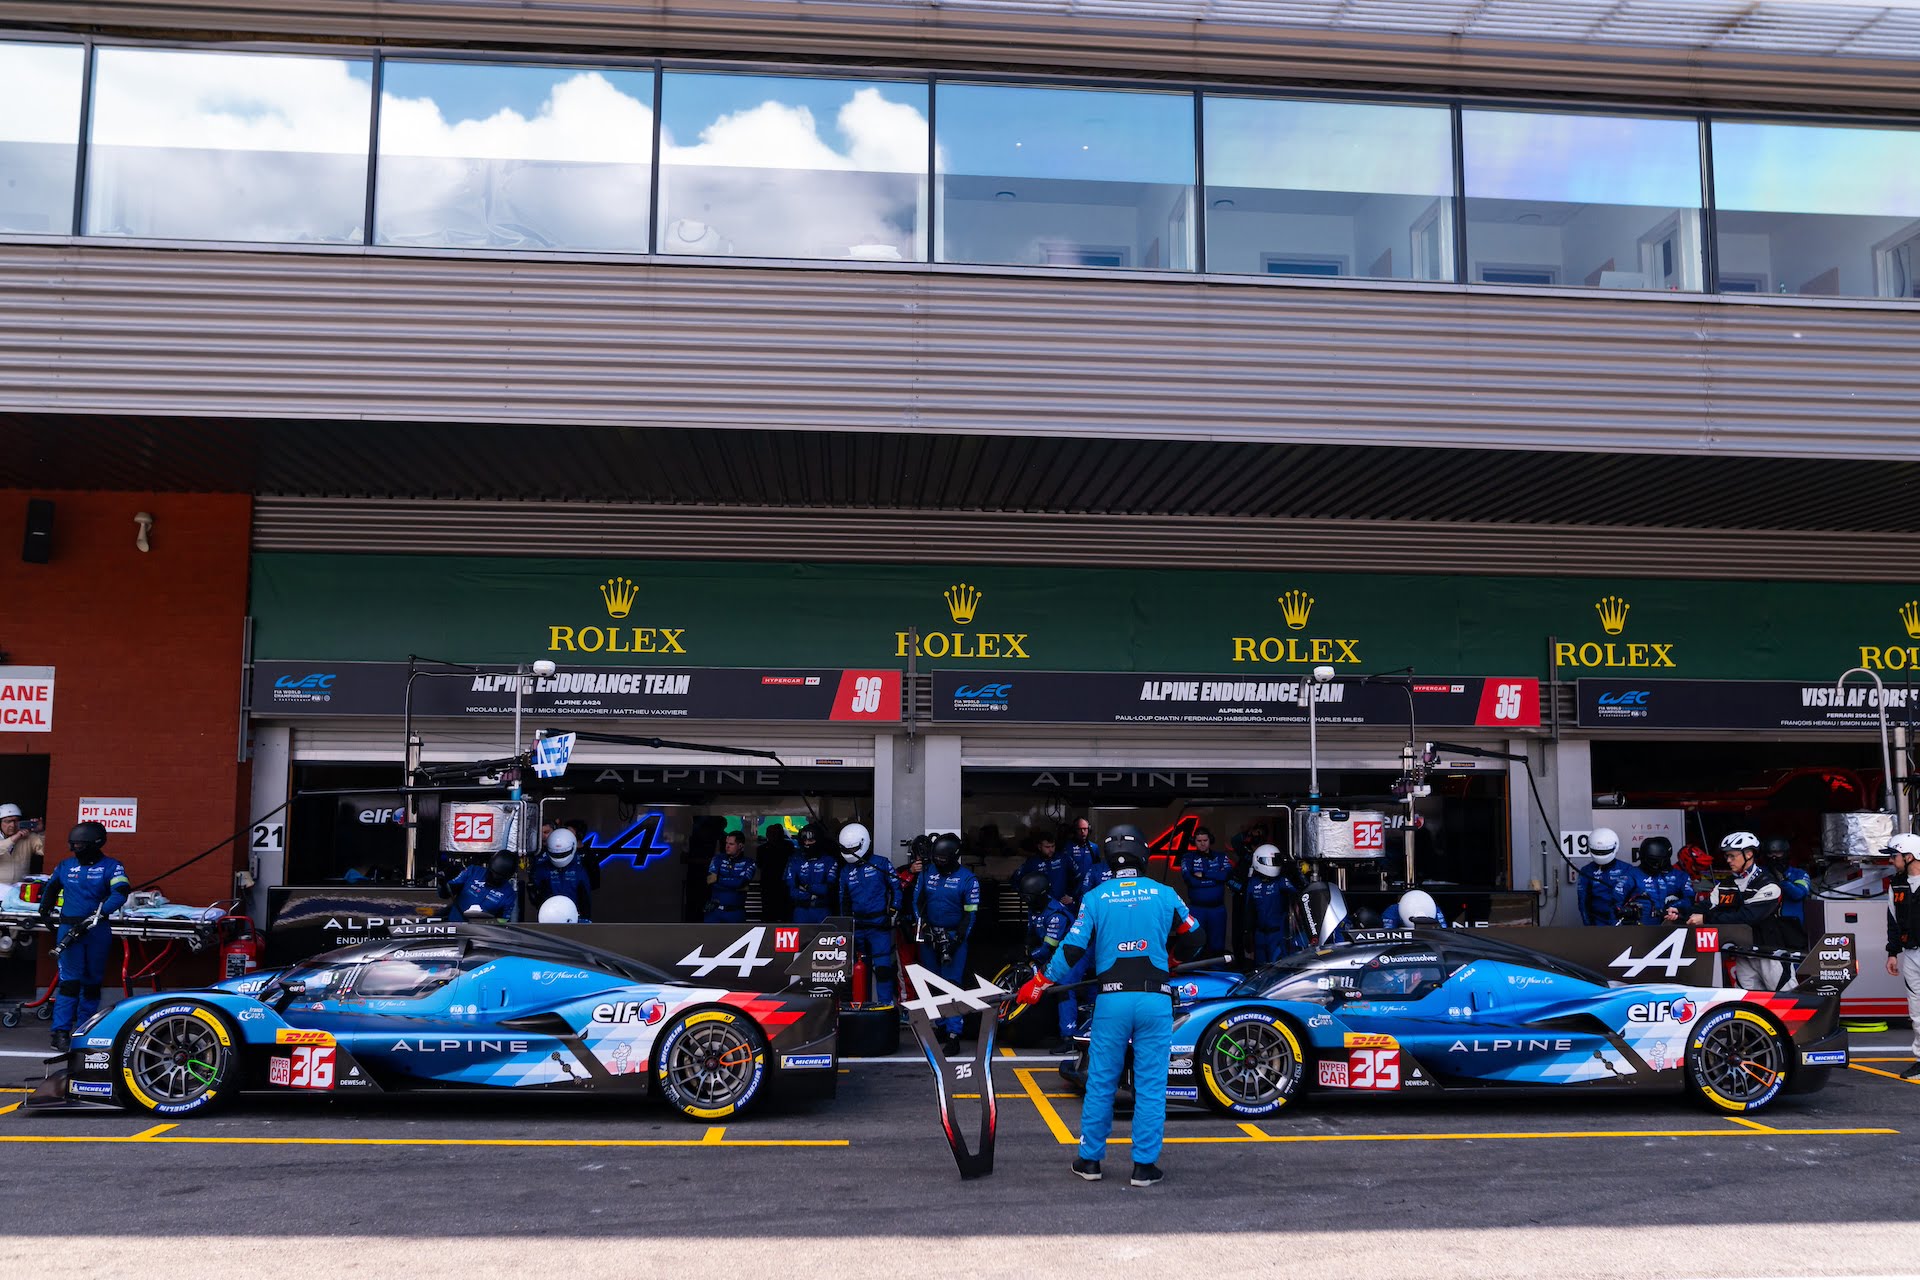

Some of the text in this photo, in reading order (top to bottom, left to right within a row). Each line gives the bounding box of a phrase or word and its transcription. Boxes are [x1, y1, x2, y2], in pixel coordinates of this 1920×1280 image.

[548, 626, 687, 653] ROLEX
[895, 632, 1030, 658] ROLEX
[1232, 637, 1361, 663] ROLEX
[1556, 642, 1676, 667] ROLEX
[275, 673, 337, 689] WEC
[471, 673, 690, 694] ALPIN ENDURANCE TEAM
[851, 676, 883, 713] 36
[954, 683, 1013, 698] WEC
[1140, 681, 1200, 701] ALPINE
[1200, 682, 1299, 702] ENDURANCE
[1598, 691, 1651, 705] WEC
[1802, 687, 1845, 707] VISTA
[1847, 688, 1867, 707] AF
[1494, 684, 1522, 720] 35
[594, 768, 780, 786] ALPINE
[1031, 771, 1209, 788] ALPINE
[82, 807, 134, 816] PIT LANE
[359, 809, 393, 823] elf
[454, 815, 493, 840] 36
[1354, 823, 1382, 847] 35
[253, 826, 283, 847] 21
[1563, 834, 1591, 855] 19
[1101, 888, 1159, 899] ALPINE
[393, 926, 457, 934] ALPINE
[1355, 931, 1413, 940] ALPINE
[776, 931, 798, 948] HY
[818, 936, 836, 945] elf
[1118, 941, 1137, 951] elf
[1697, 931, 1718, 948] HY
[1824, 937, 1840, 945] elf
[1390, 954, 1438, 962] businessolver
[149, 1006, 192, 1022] MICHELIN
[592, 1001, 639, 1024] elf
[1233, 1013, 1272, 1022] MICHELIN
[1627, 1001, 1671, 1023] elf
[1702, 1012, 1731, 1035] MICHELIN
[285, 1032, 328, 1042] DHL
[660, 1024, 683, 1064] MICHELIN
[1352, 1036, 1392, 1045] DHL
[390, 1039, 528, 1052] ALPINE
[1448, 1039, 1572, 1052] ALPINE
[271, 1058, 289, 1069] HYPER
[290, 1046, 336, 1088] 36
[955, 1063, 973, 1079] 35
[1320, 1062, 1346, 1071] HYPER
[1350, 1050, 1400, 1088] 35
[271, 1067, 288, 1082] CAR
[1320, 1070, 1347, 1085] CAR
[78, 1085, 111, 1093] MICHELIN
[737, 1069, 762, 1107] MICHELIN
[1749, 1084, 1779, 1108] MICHELIN
[158, 1100, 201, 1112] MICHELIN
[1234, 1104, 1273, 1113] MICHELIN
